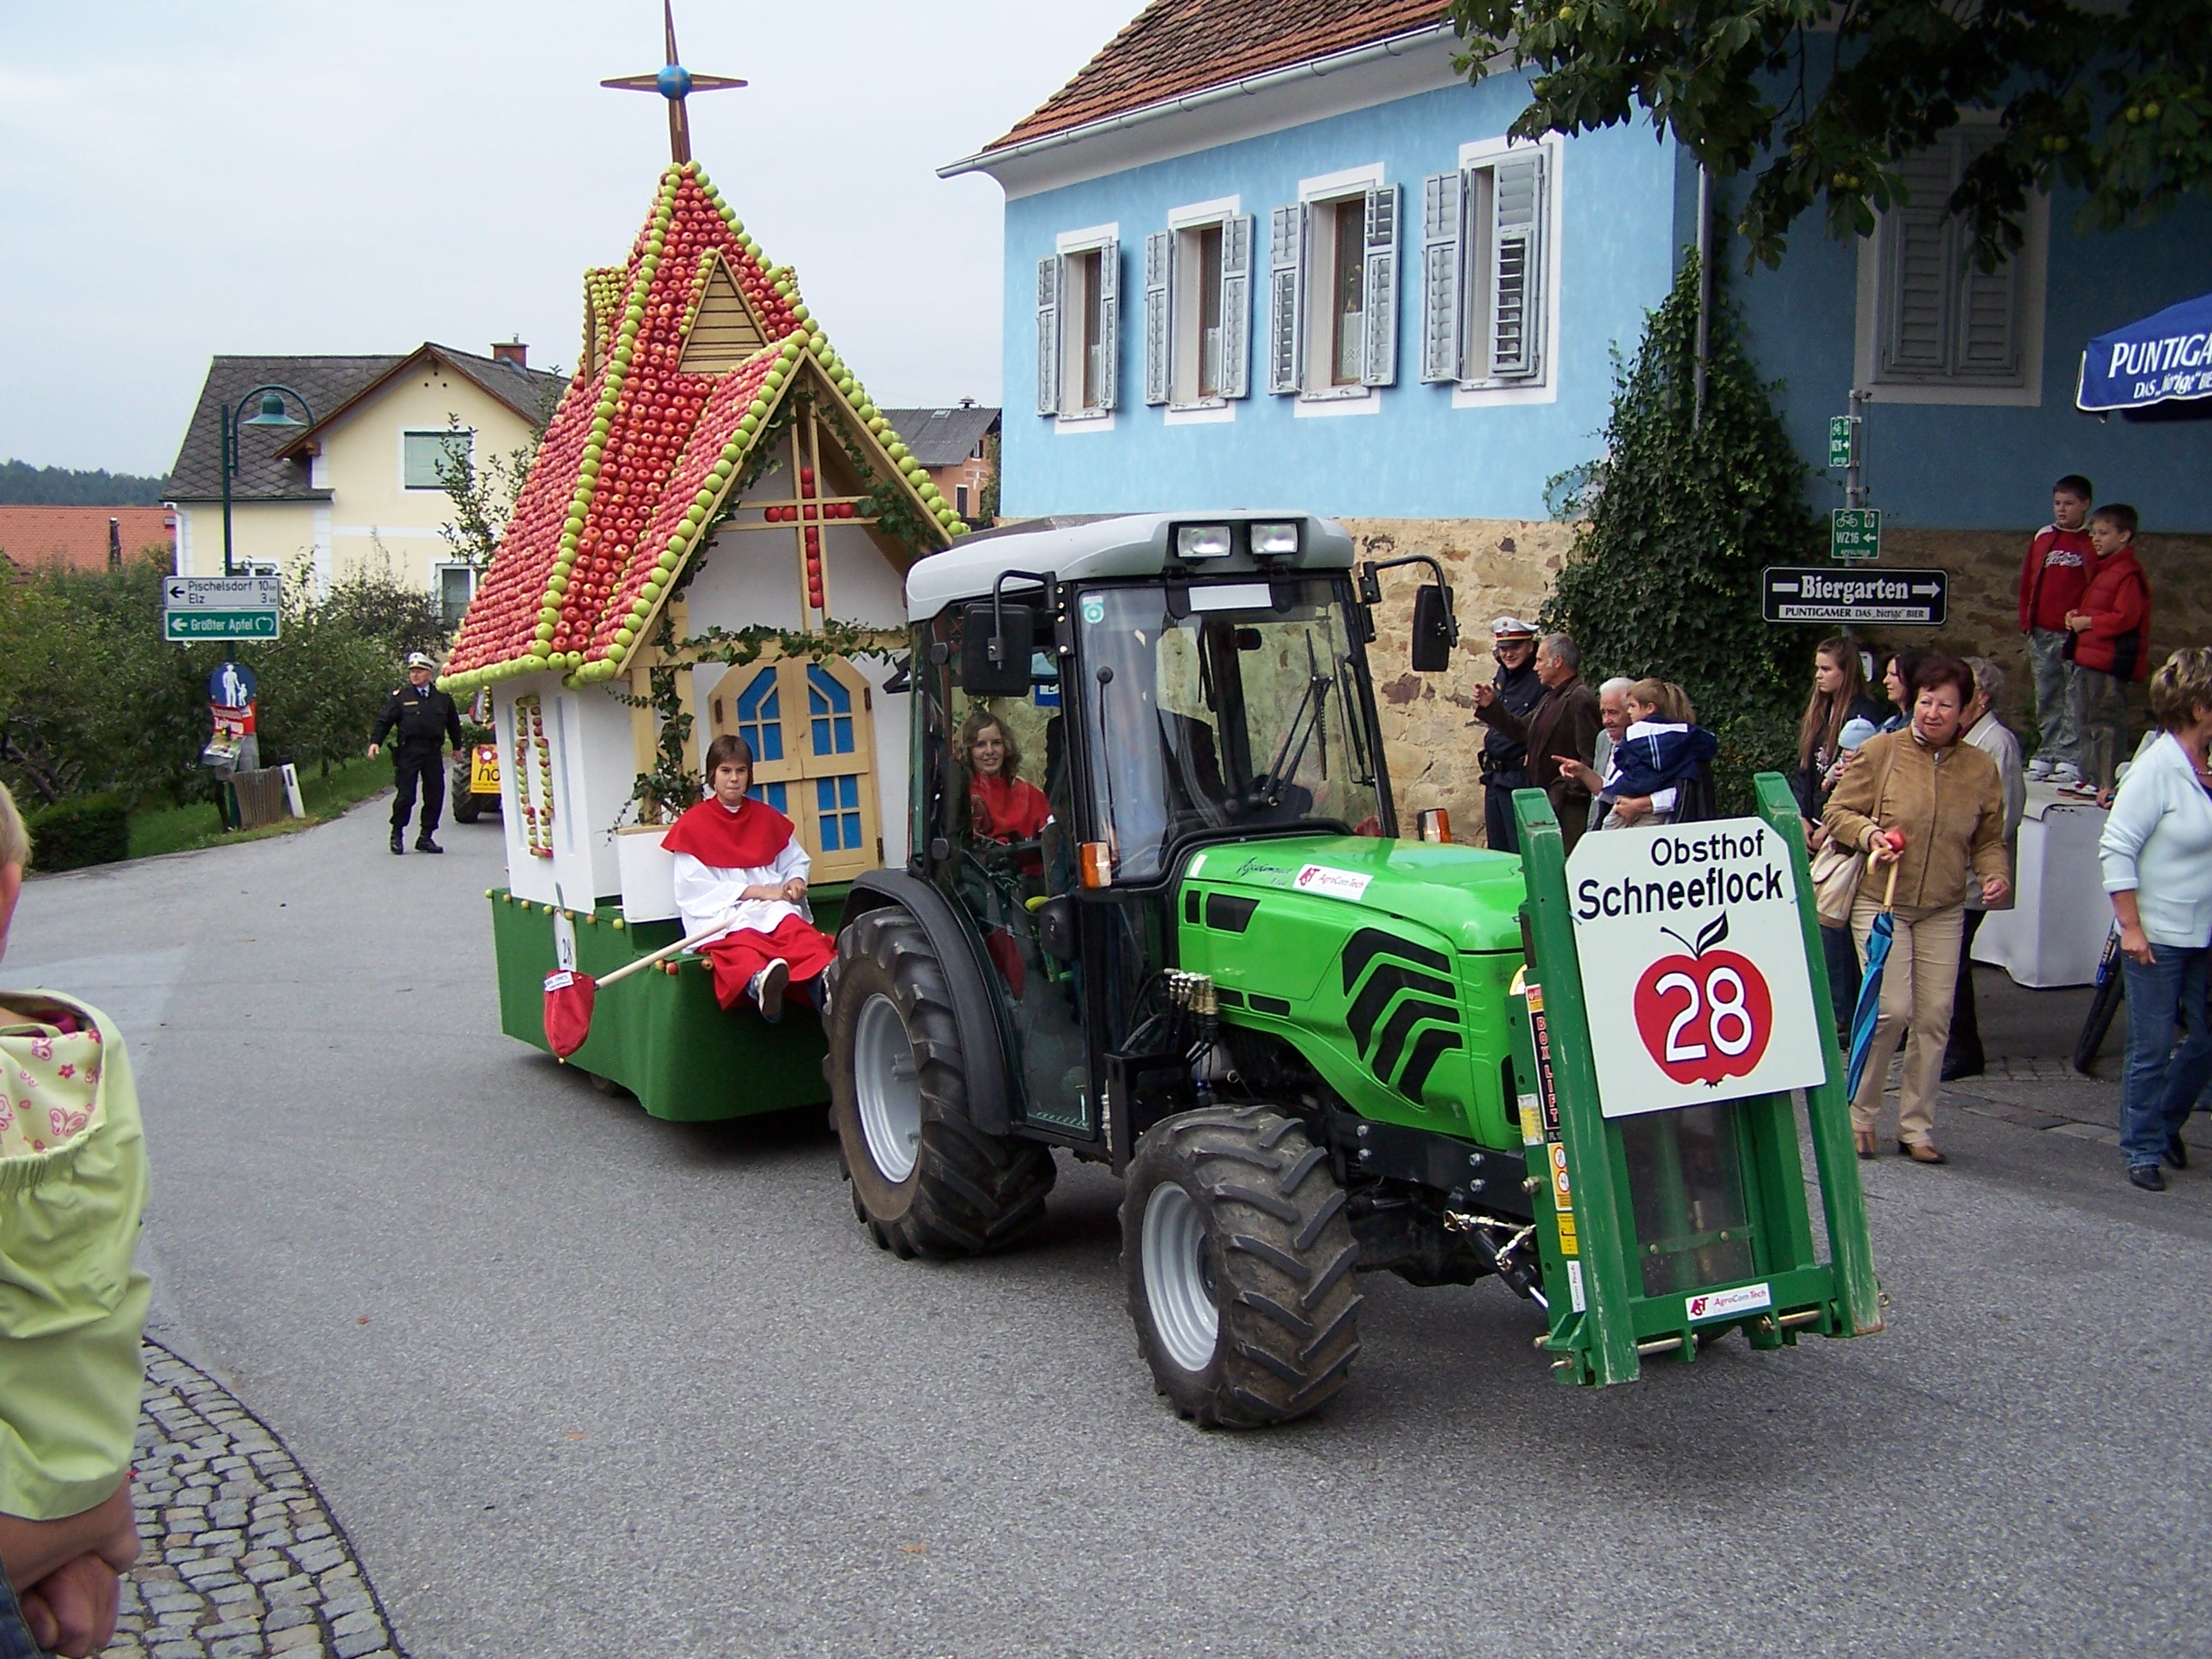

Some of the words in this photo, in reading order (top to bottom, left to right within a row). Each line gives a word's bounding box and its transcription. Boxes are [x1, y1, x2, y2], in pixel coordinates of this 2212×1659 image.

[1836, 532, 1859, 544] WZ16
[189, 580, 252, 591] Pischelsdorf
[258, 580, 268, 591] 10
[189, 593, 205, 604] Elz
[261, 593, 267, 603] 3
[1801, 575, 1908, 604] Biergarten
[191, 618, 226, 631] Größter
[228, 618, 252, 633] Apfel
[1785, 607, 1851, 617] PUNTIGAMER
[1855, 609, 1871, 617] DAS
[1650, 829, 1764, 866] Obsthof
[1577, 863, 1784, 920] Schneeflock
[562, 938, 573, 965] 28
[1654, 966, 1755, 1063] 28
[1544, 1064, 1559, 1123] LIFT
